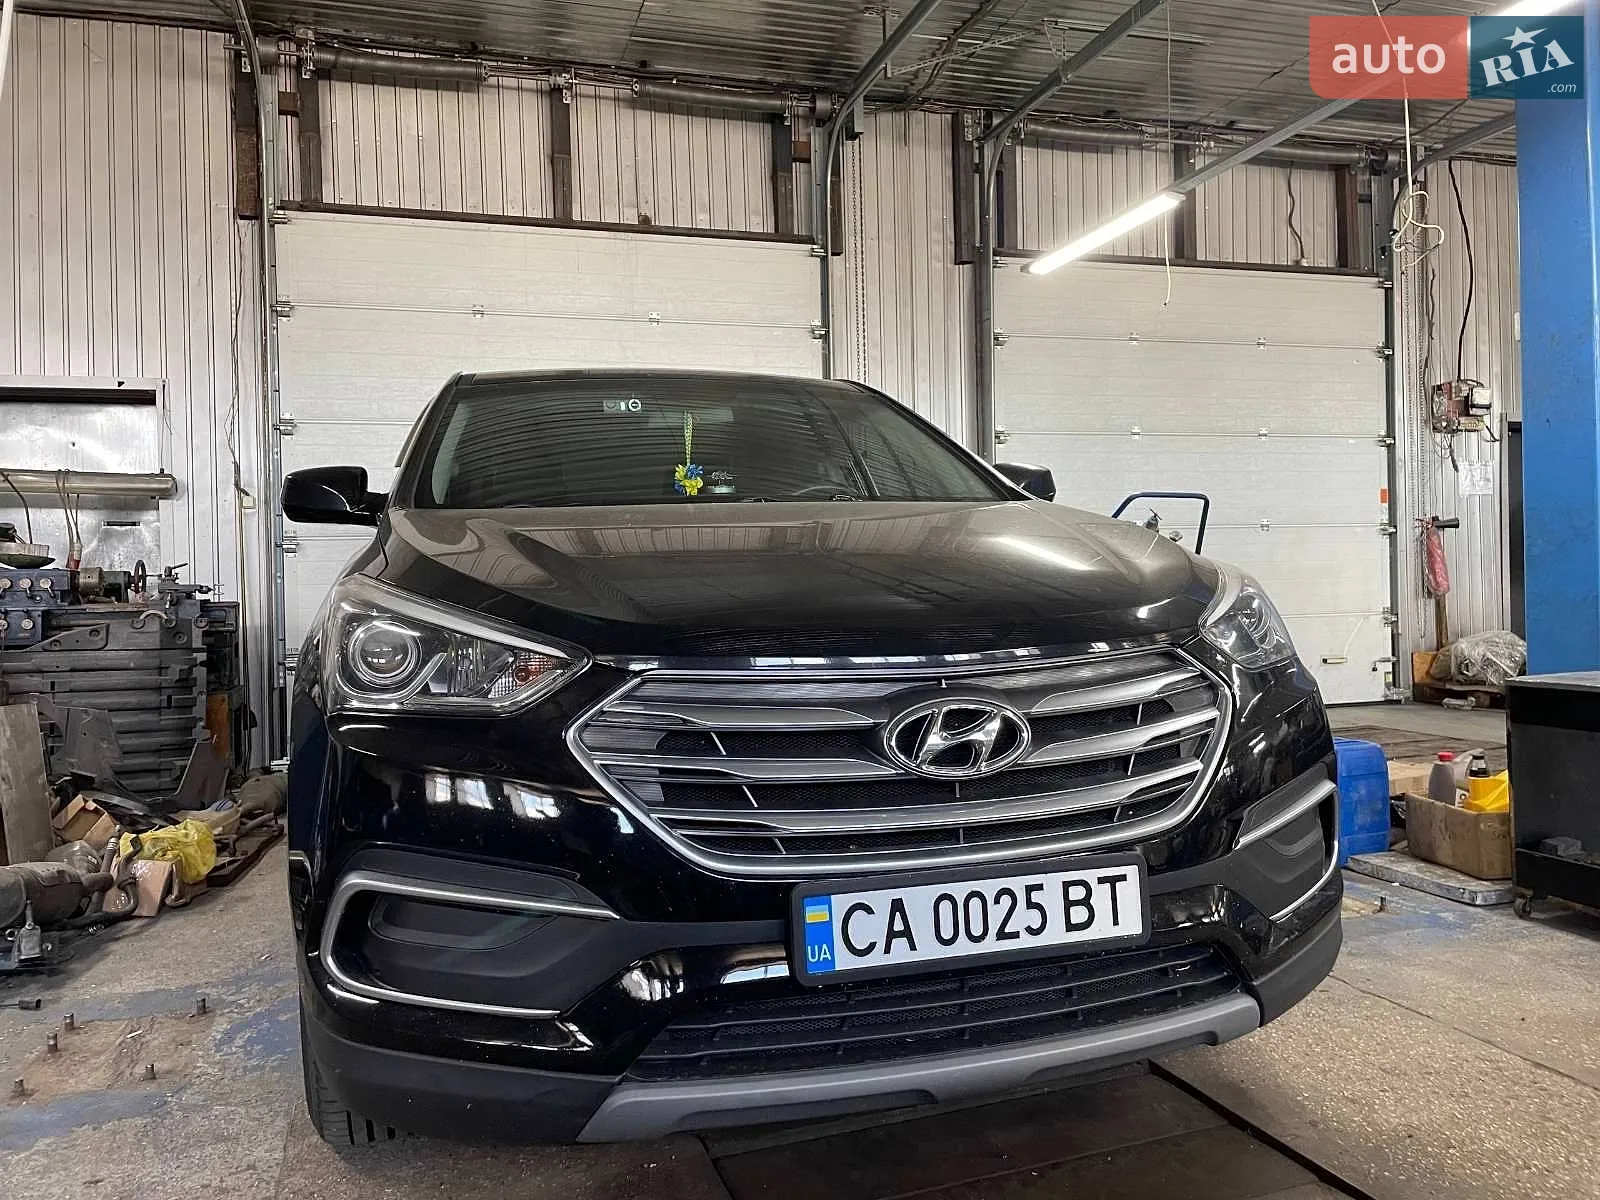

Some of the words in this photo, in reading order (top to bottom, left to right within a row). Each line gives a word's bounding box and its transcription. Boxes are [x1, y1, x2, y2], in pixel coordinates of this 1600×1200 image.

[840, 897, 918, 958] CA
[933, 882, 1049, 947] 0025
[1061, 873, 1128, 934] BT
[807, 943, 832, 963] UA
